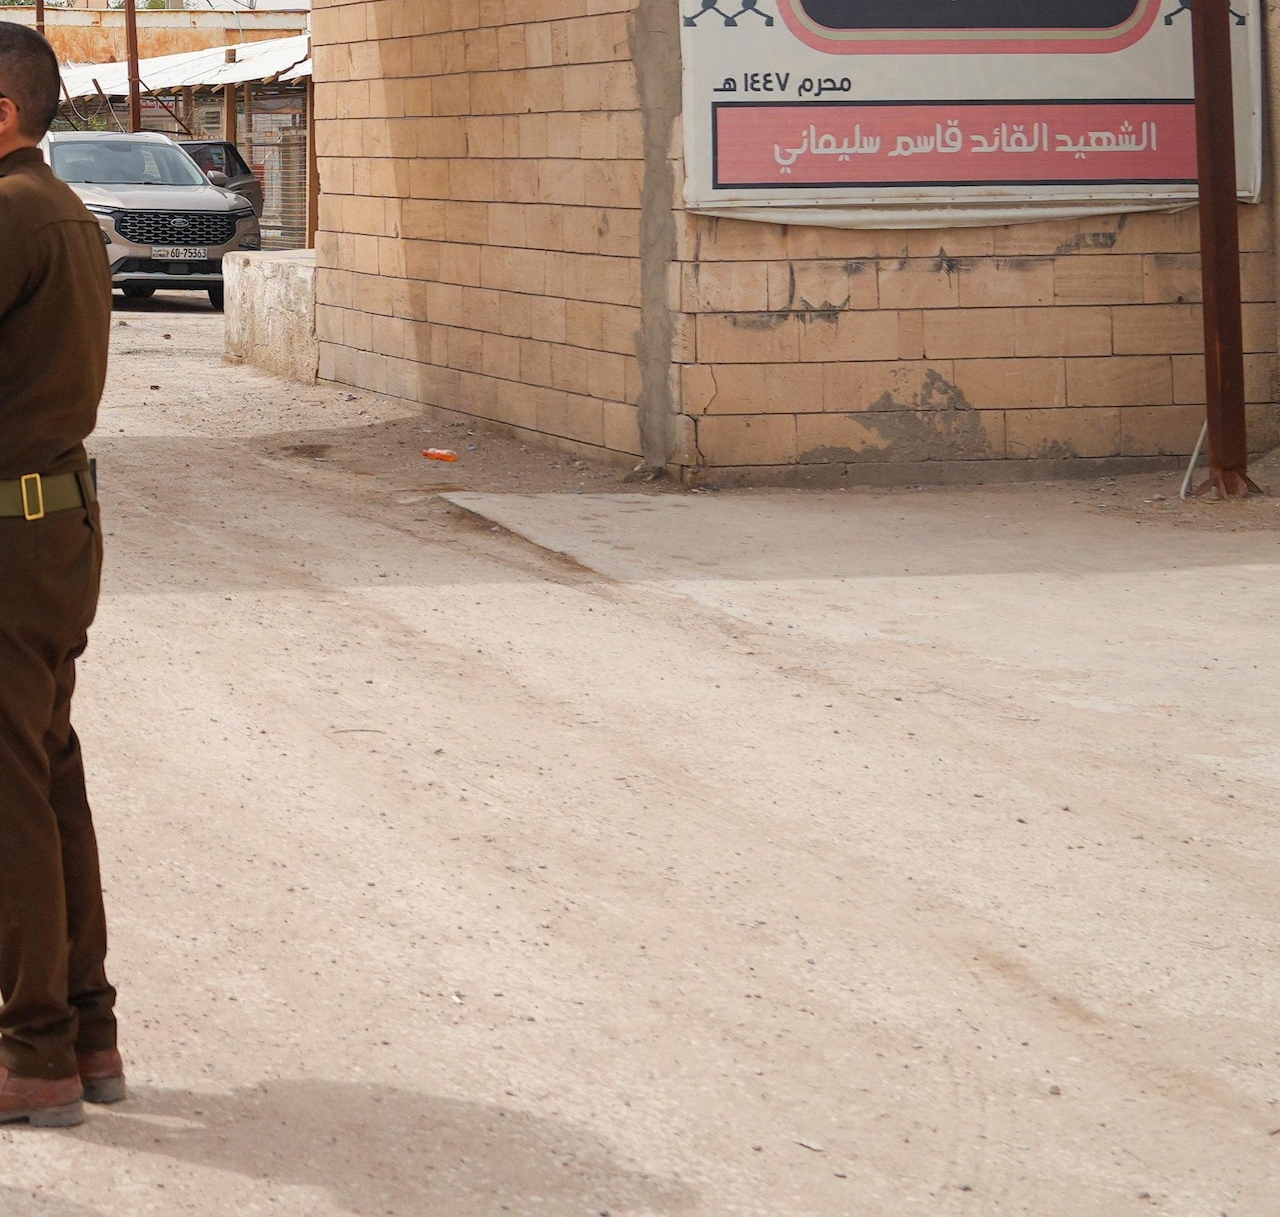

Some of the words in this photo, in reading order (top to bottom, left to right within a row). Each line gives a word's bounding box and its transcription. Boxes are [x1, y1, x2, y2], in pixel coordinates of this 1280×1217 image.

[743, 72, 790, 93] ١٤٤٧
[797, 77, 852, 97] محرم
[773, 123, 881, 175] سليماني
[887, 118, 963, 158] قاسم
[969, 122, 1049, 153] القائد
[1054, 119, 1158, 161] الشهيد
